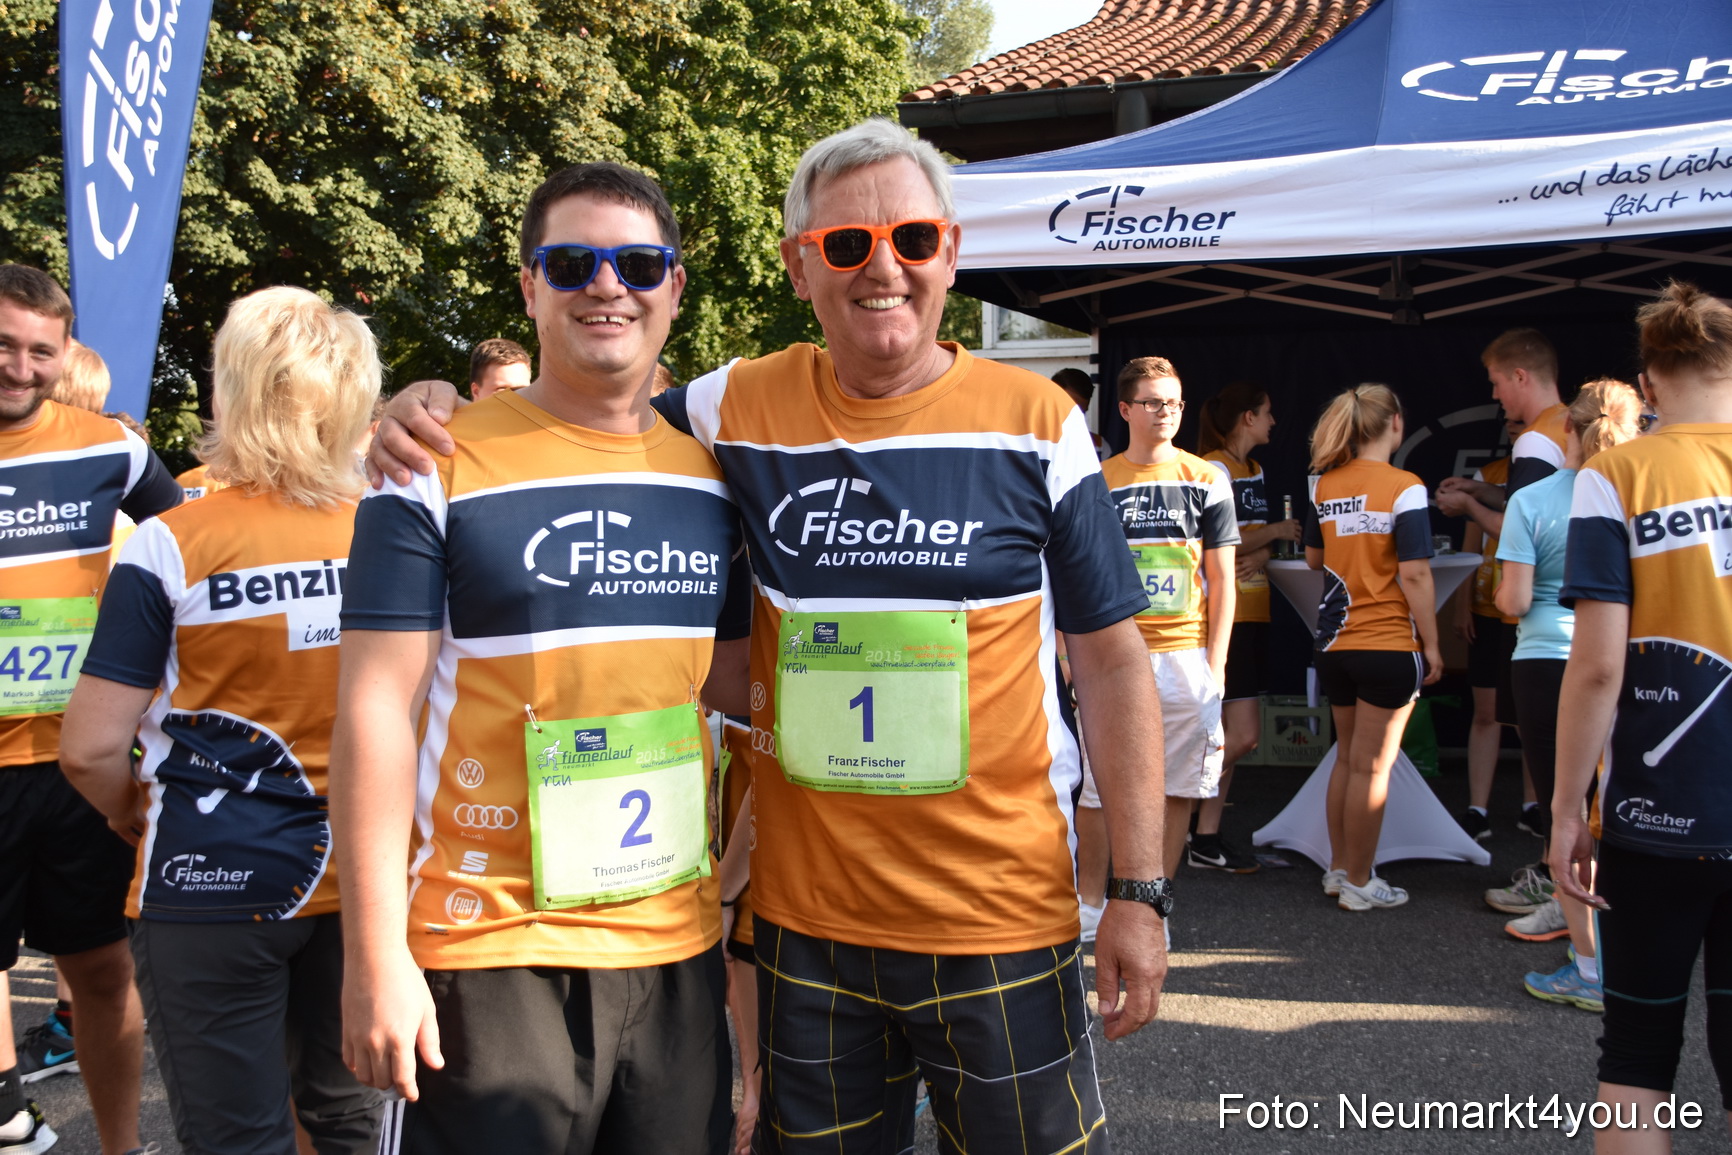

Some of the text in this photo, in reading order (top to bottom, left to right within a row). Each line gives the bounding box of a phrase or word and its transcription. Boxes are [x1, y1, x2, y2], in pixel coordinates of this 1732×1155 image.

[1530, 170, 1586, 200] und
[1596, 162, 1651, 187] das
[1604, 191, 1689, 227] fährt
[1081, 206, 1236, 237] Fischer
[1092, 236, 1220, 251] AUTOMOBILE
[1123, 506, 1186, 522] Fischer
[800, 508, 983, 546] Fischer
[1129, 520, 1182, 528] AUTOMOBILE
[570, 541, 720, 577] Fischer
[814, 551, 968, 567] AUTOMOBILE
[588, 580, 718, 596] AUTOMOBILE
[801, 641, 863, 655] firmenlauf
[865, 650, 902, 662] 2015
[0, 644, 78, 682] 427
[3, 690, 34, 698] Markus
[1634, 686, 1679, 703] km/h
[850, 686, 874, 742] 1
[562, 745, 634, 764] firmenlauf
[635, 748, 667, 764] 2015
[828, 755, 906, 768] Franz Fischer
[619, 789, 653, 849] 2
[1629, 807, 1696, 828] Fischer
[460, 830, 485, 841] Audi
[1634, 822, 1690, 835] AUTOMOBILE
[592, 853, 675, 878] Thomas Fischer
[175, 866, 254, 882] Fischer
[600, 869, 670, 888] Fischer Automobile GmbH
[181, 883, 247, 892] AUTOMOBILE
[453, 896, 476, 916] FIAT
